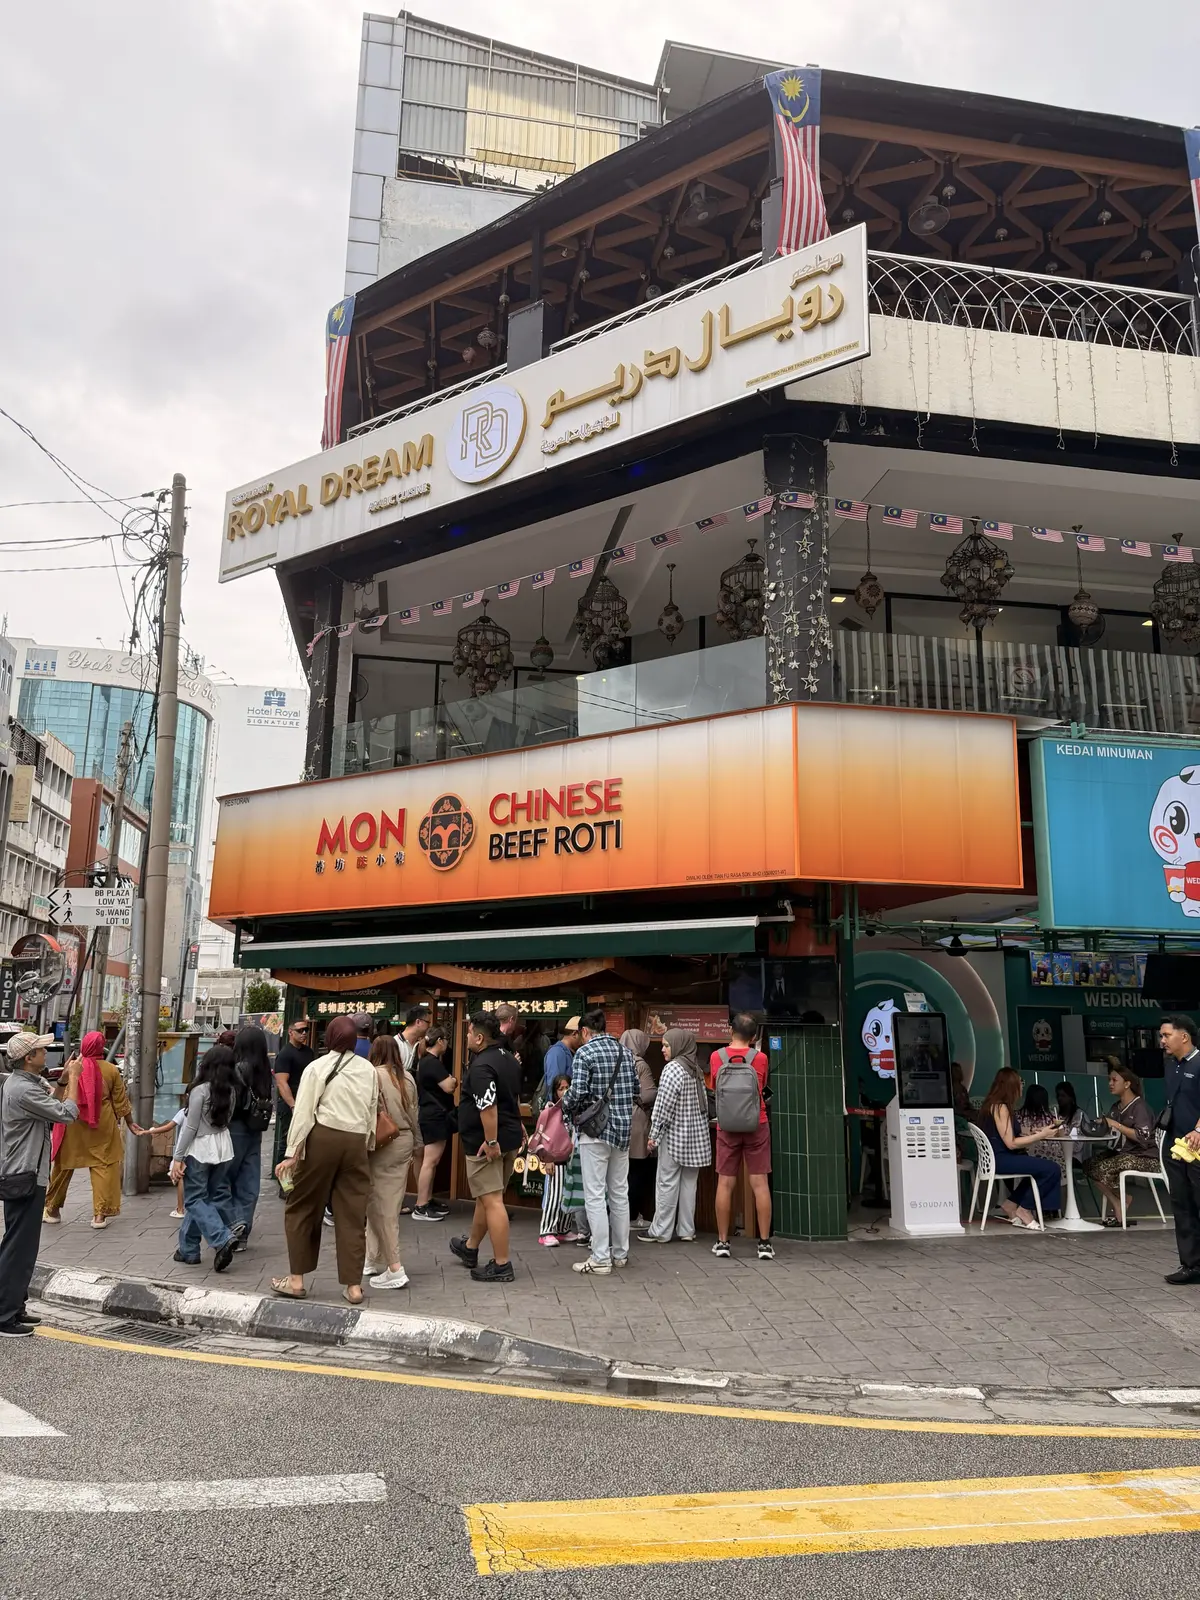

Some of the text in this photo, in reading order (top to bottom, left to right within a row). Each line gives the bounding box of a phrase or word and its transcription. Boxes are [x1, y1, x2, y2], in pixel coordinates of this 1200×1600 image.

[227, 433, 434, 541] ROYAL DREAM
[247, 706, 301, 719] Hotel Royal
[247, 718, 300, 727] SIGNATURE
[1056, 744, 1153, 760] KEDAI MINUMAN
[488, 777, 623, 826] CHINESE
[316, 807, 406, 856] MON
[488, 826, 549, 861] BEEF
[554, 818, 622, 855] ROTI
[94, 889, 130, 898] BB PLAZA
[98, 898, 130, 906] LOW YAT
[105, 917, 130, 925] LOT 10
[1, 970, 13, 1018] HOTEL
[318, 1001, 387, 1014] 非物质文化遗产
